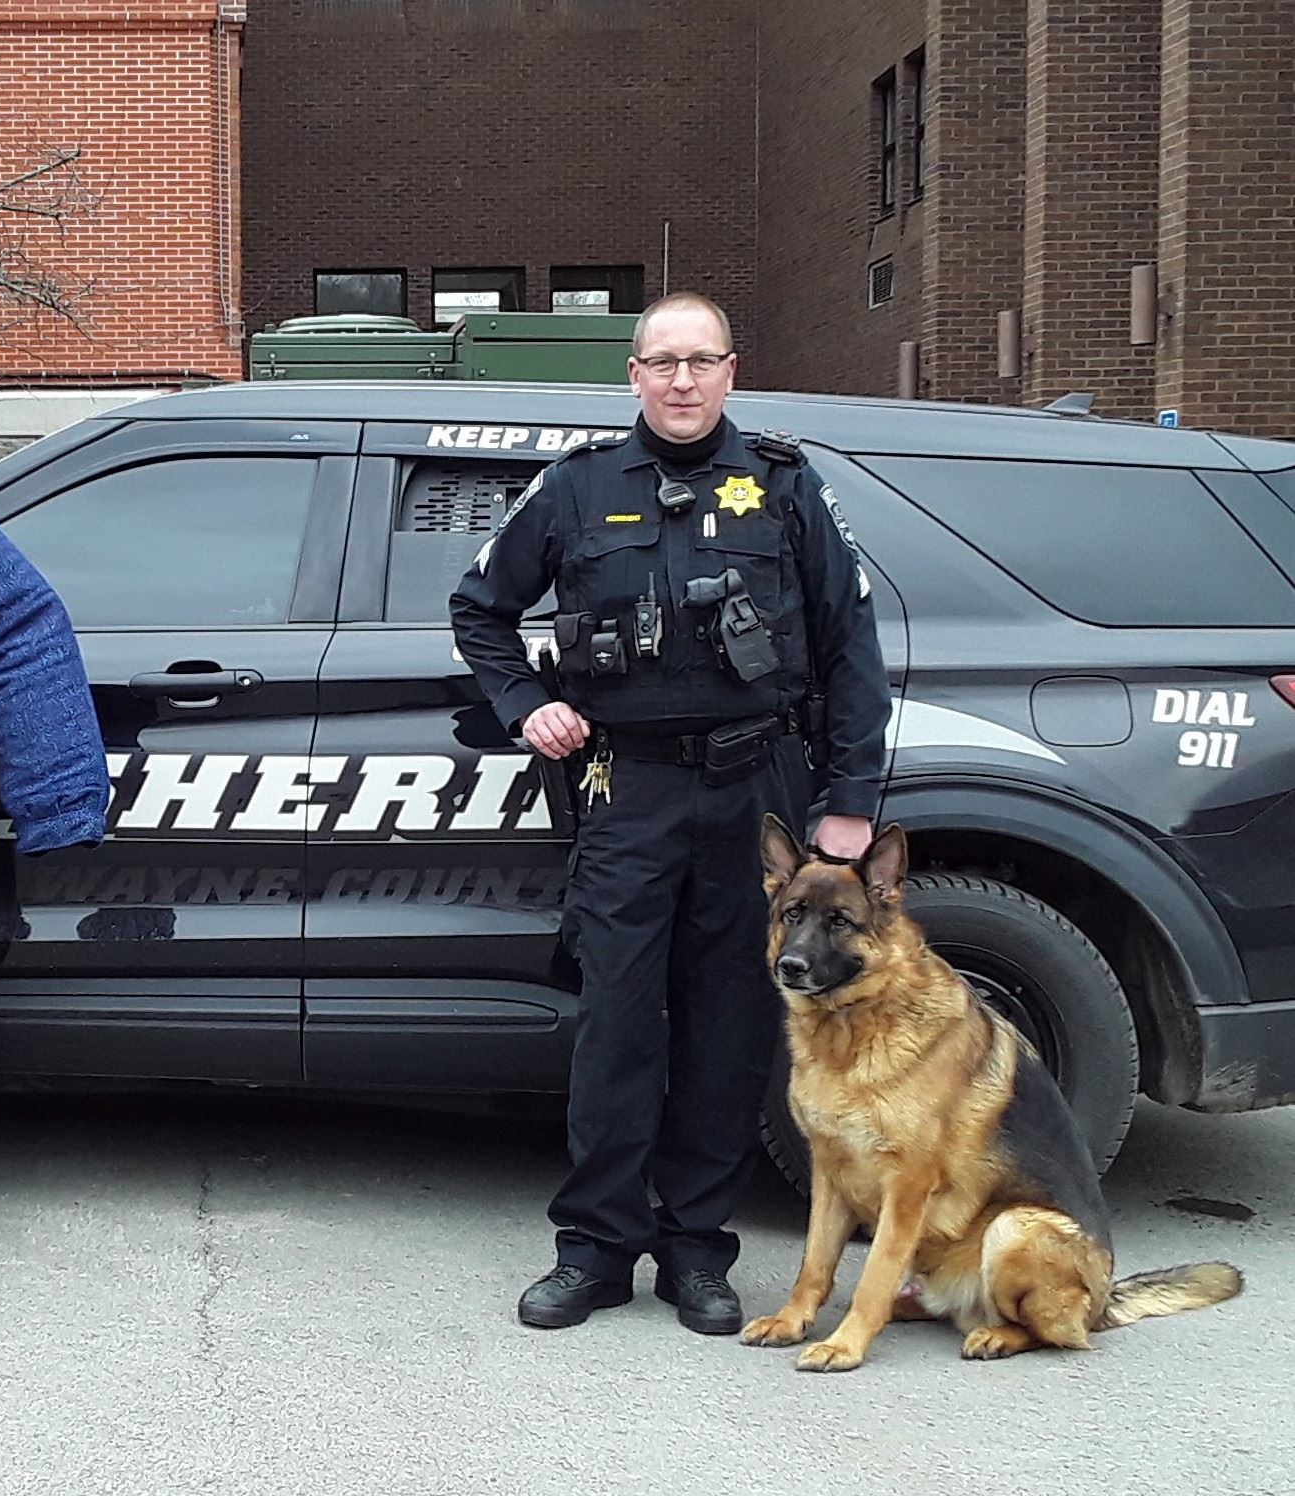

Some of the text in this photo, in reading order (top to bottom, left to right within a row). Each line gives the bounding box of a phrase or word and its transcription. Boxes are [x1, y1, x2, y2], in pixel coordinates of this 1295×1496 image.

[426, 425, 530, 450] KEEP
[1151, 688, 1257, 727] DIAL
[1177, 730, 1240, 769] 911
[39, 866, 301, 904] WAYNE
